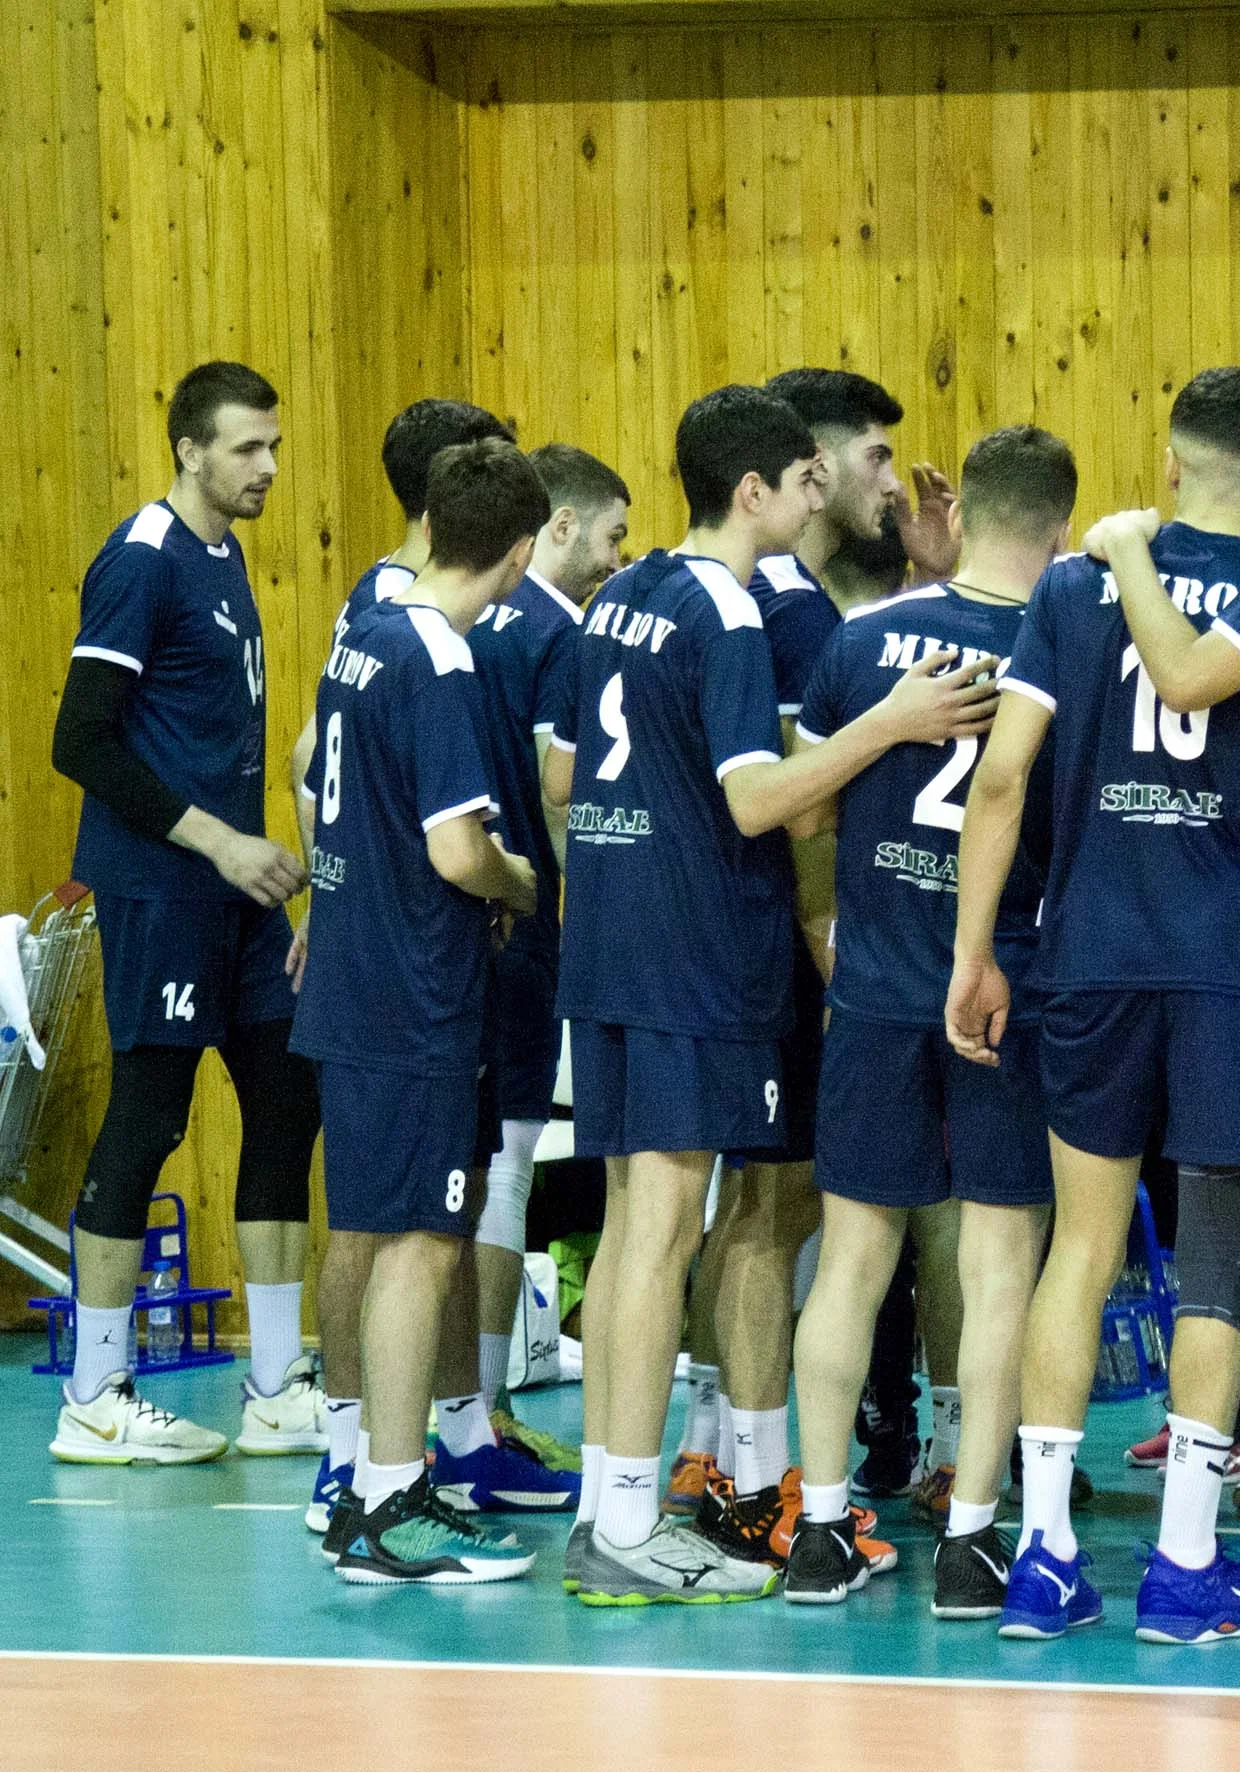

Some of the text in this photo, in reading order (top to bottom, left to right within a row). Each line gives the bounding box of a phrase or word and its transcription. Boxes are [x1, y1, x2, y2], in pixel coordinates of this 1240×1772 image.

[1099, 571, 1239, 617] MRO
[321, 644, 384, 692] UROV
[321, 710, 342, 825] 8
[911, 734, 978, 833] 2
[162, 981, 195, 1021] 14
[764, 1080, 780, 1123] 9
[446, 1169, 466, 1212] 8
